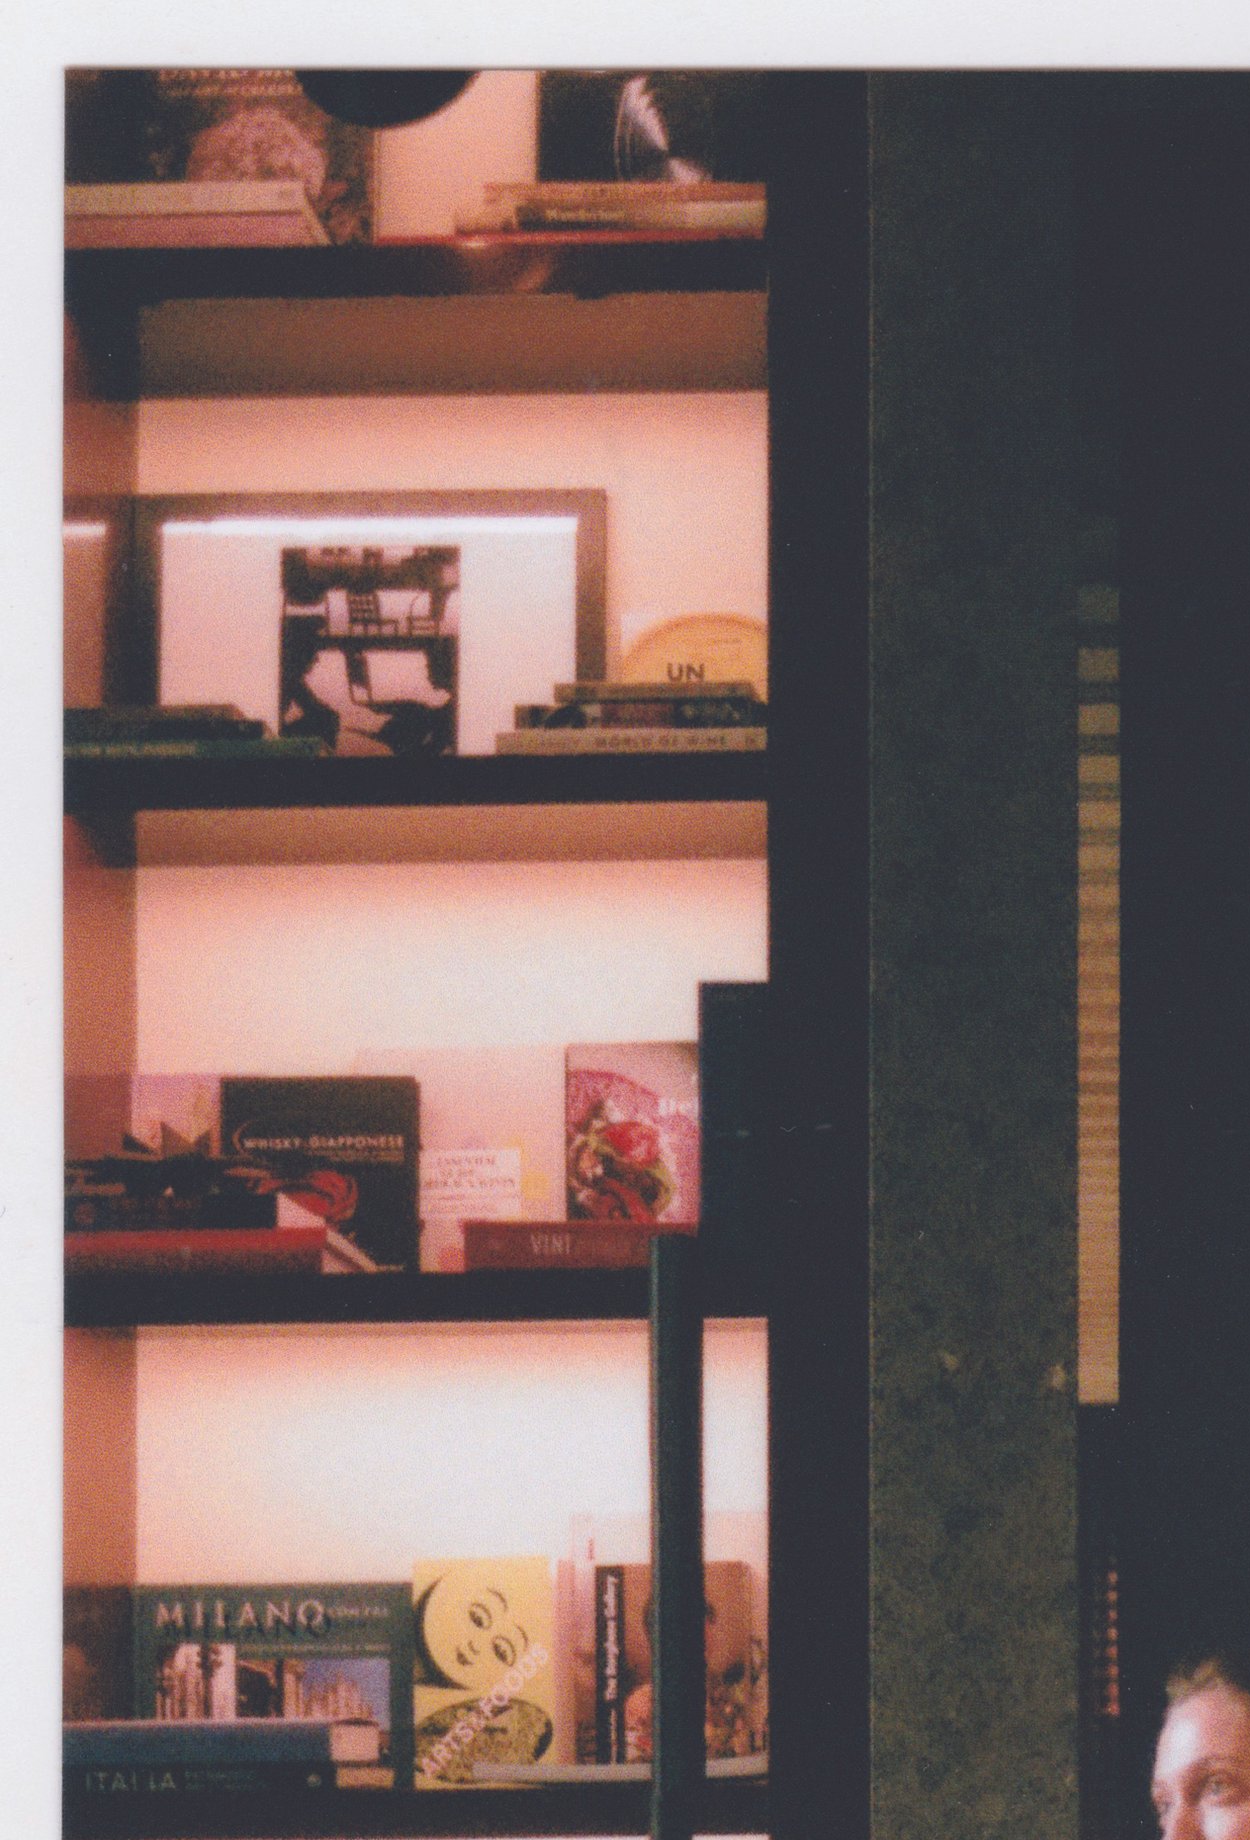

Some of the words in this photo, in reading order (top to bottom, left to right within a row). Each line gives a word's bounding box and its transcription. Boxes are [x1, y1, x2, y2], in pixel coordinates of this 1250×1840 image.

[667, 662, 705, 682] UN
[242, 1137, 302, 1149] WHISKY
[308, 1134, 404, 1149] GIAPPONESE
[529, 1233, 571, 1255] VINI
[602, 1575, 621, 1619] Gallery
[154, 1599, 326, 1629] MILANO
[603, 1679, 619, 1702] The
[421, 1721, 474, 1778] ARTS
[478, 1642, 549, 1717] FOODS
